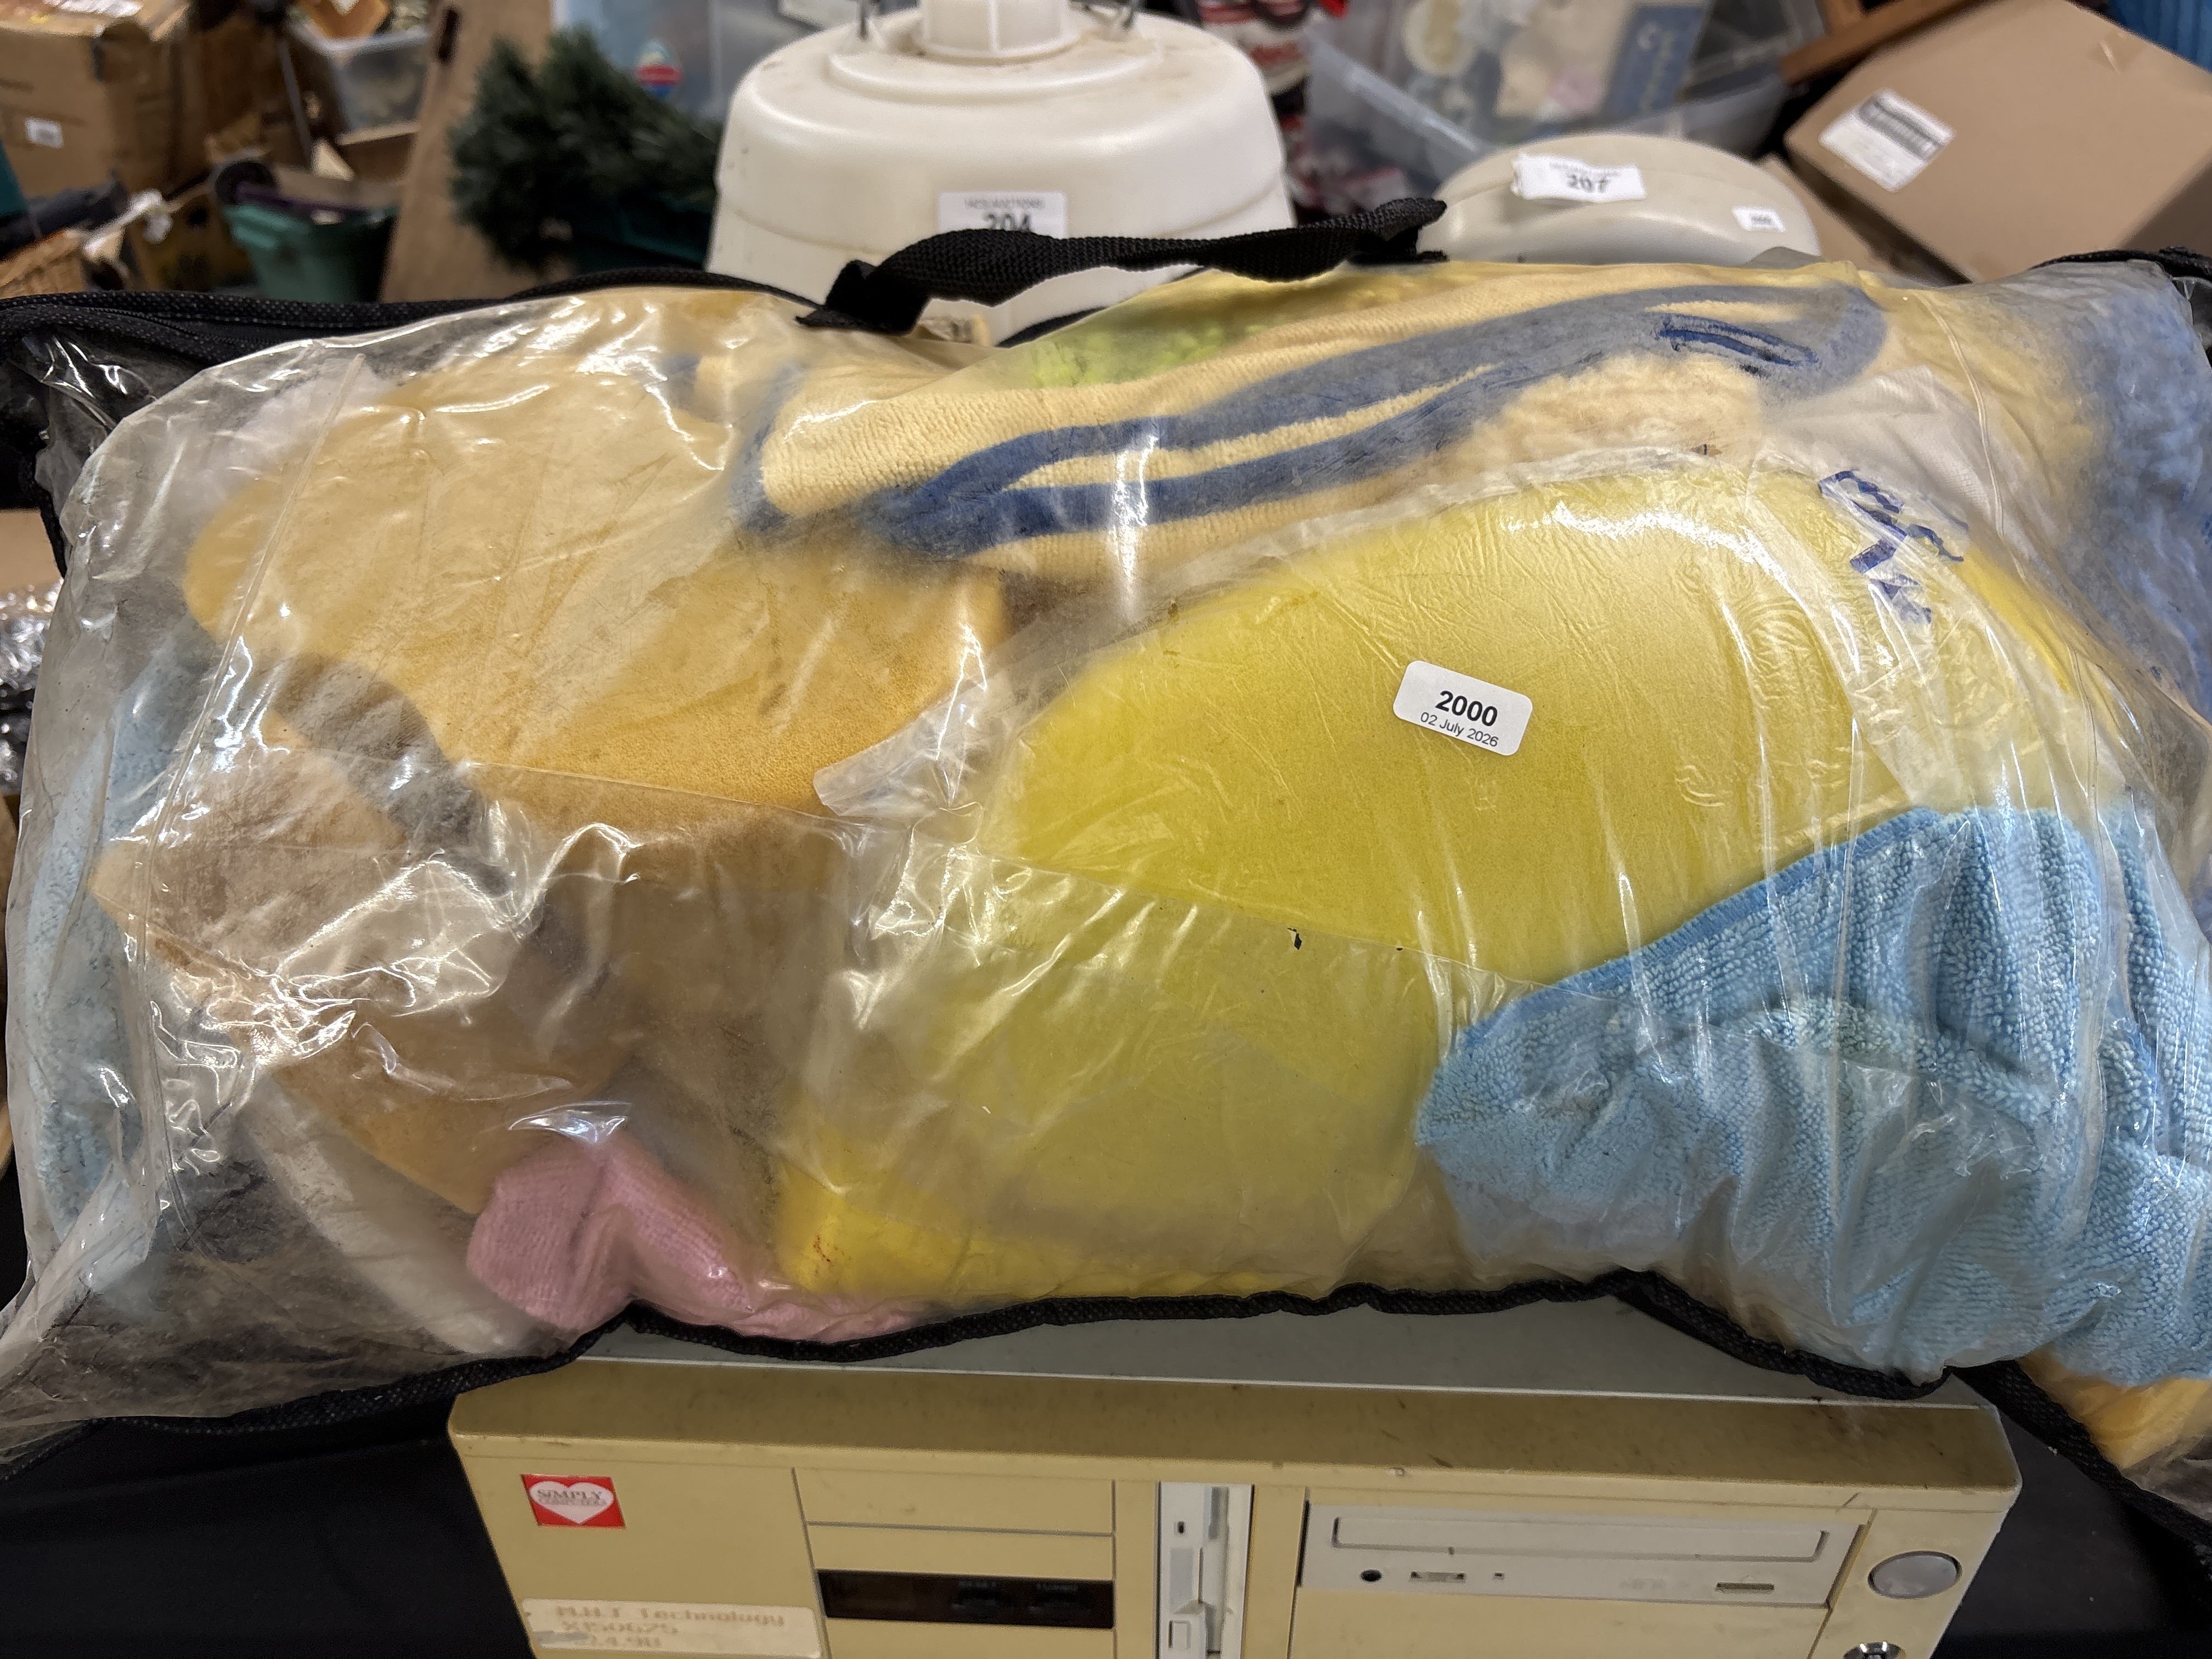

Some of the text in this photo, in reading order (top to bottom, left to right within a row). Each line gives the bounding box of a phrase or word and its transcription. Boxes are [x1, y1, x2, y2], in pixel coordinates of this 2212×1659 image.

[1435, 690, 1498, 727] 2000
[1420, 712, 1499, 747] 02 July 2026
